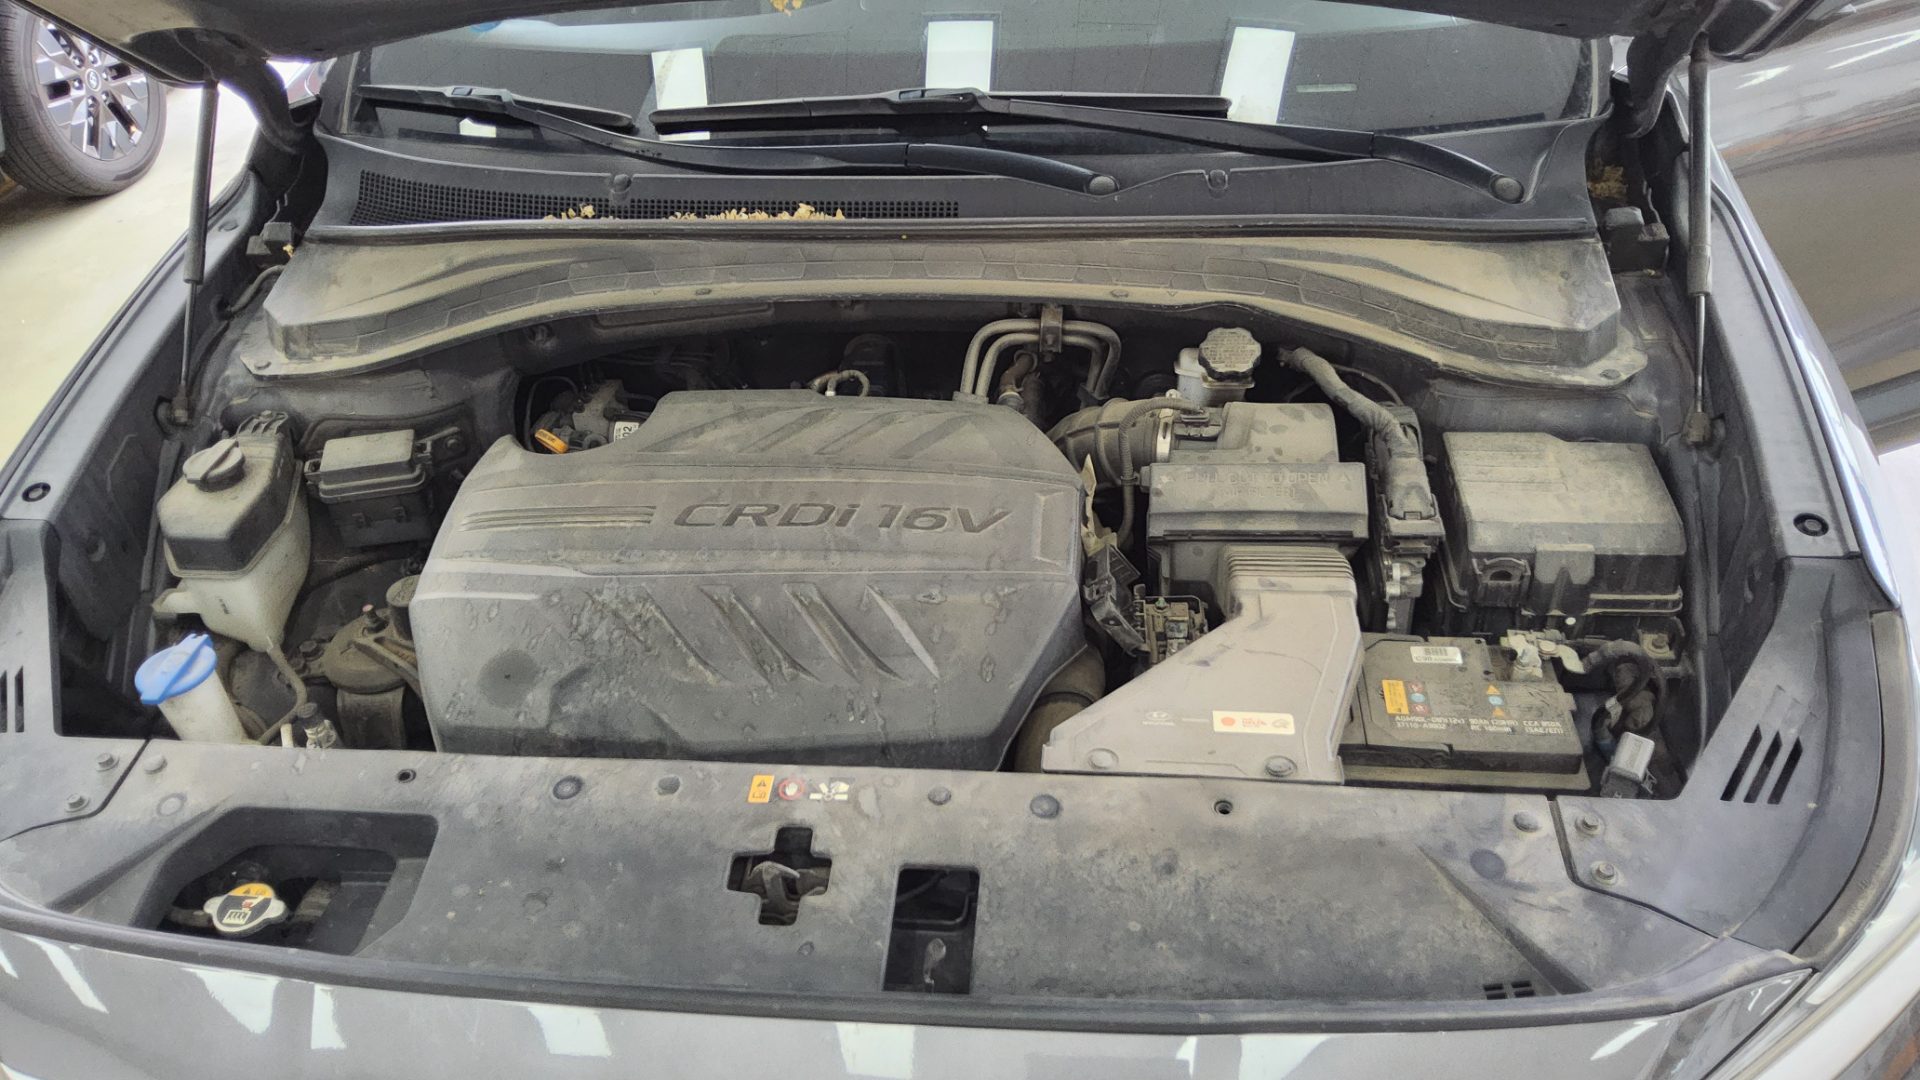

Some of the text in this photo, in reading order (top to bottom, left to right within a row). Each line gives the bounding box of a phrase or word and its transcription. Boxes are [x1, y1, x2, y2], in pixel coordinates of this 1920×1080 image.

[1229, 472, 1256, 485] OUT
[1287, 472, 1329, 485] OPEN
[673, 502, 1012, 535] CRDi 16V
